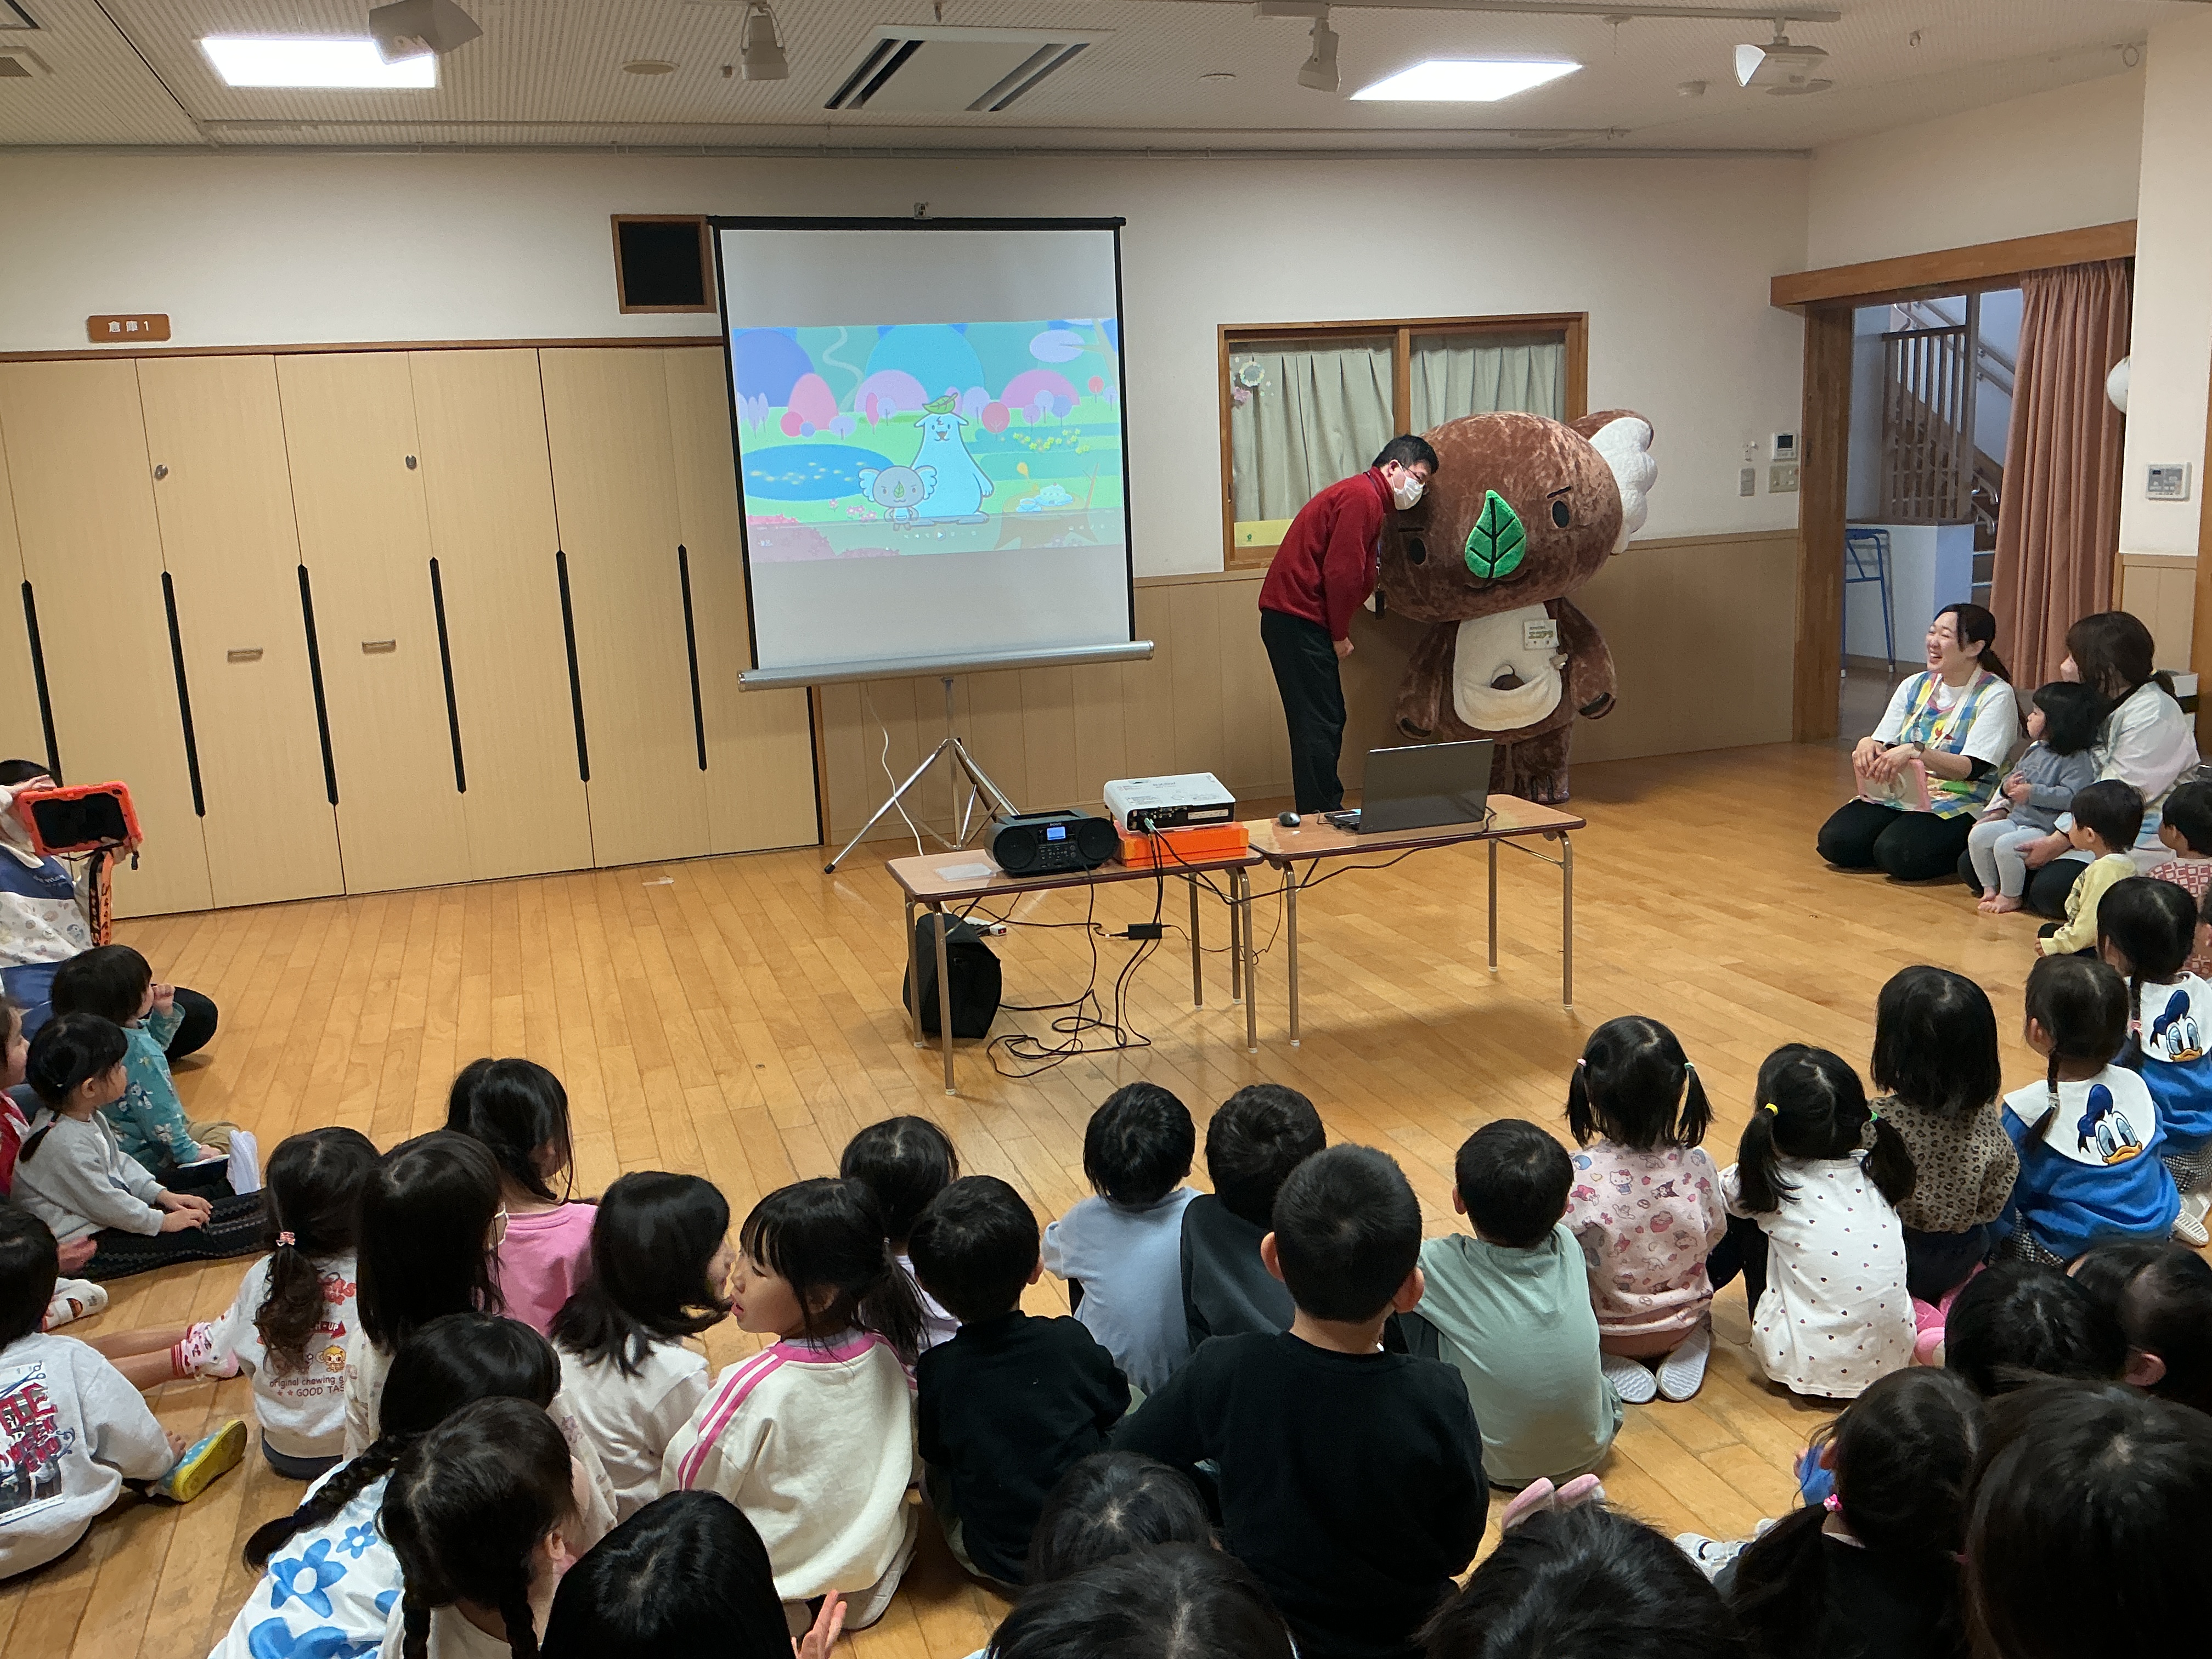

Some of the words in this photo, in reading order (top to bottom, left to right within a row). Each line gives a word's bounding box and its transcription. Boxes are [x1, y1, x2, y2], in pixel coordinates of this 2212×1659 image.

[269, 1378, 298, 1389] original
[302, 1375, 335, 1385] chewing
[296, 1387, 323, 1397] GOOD
